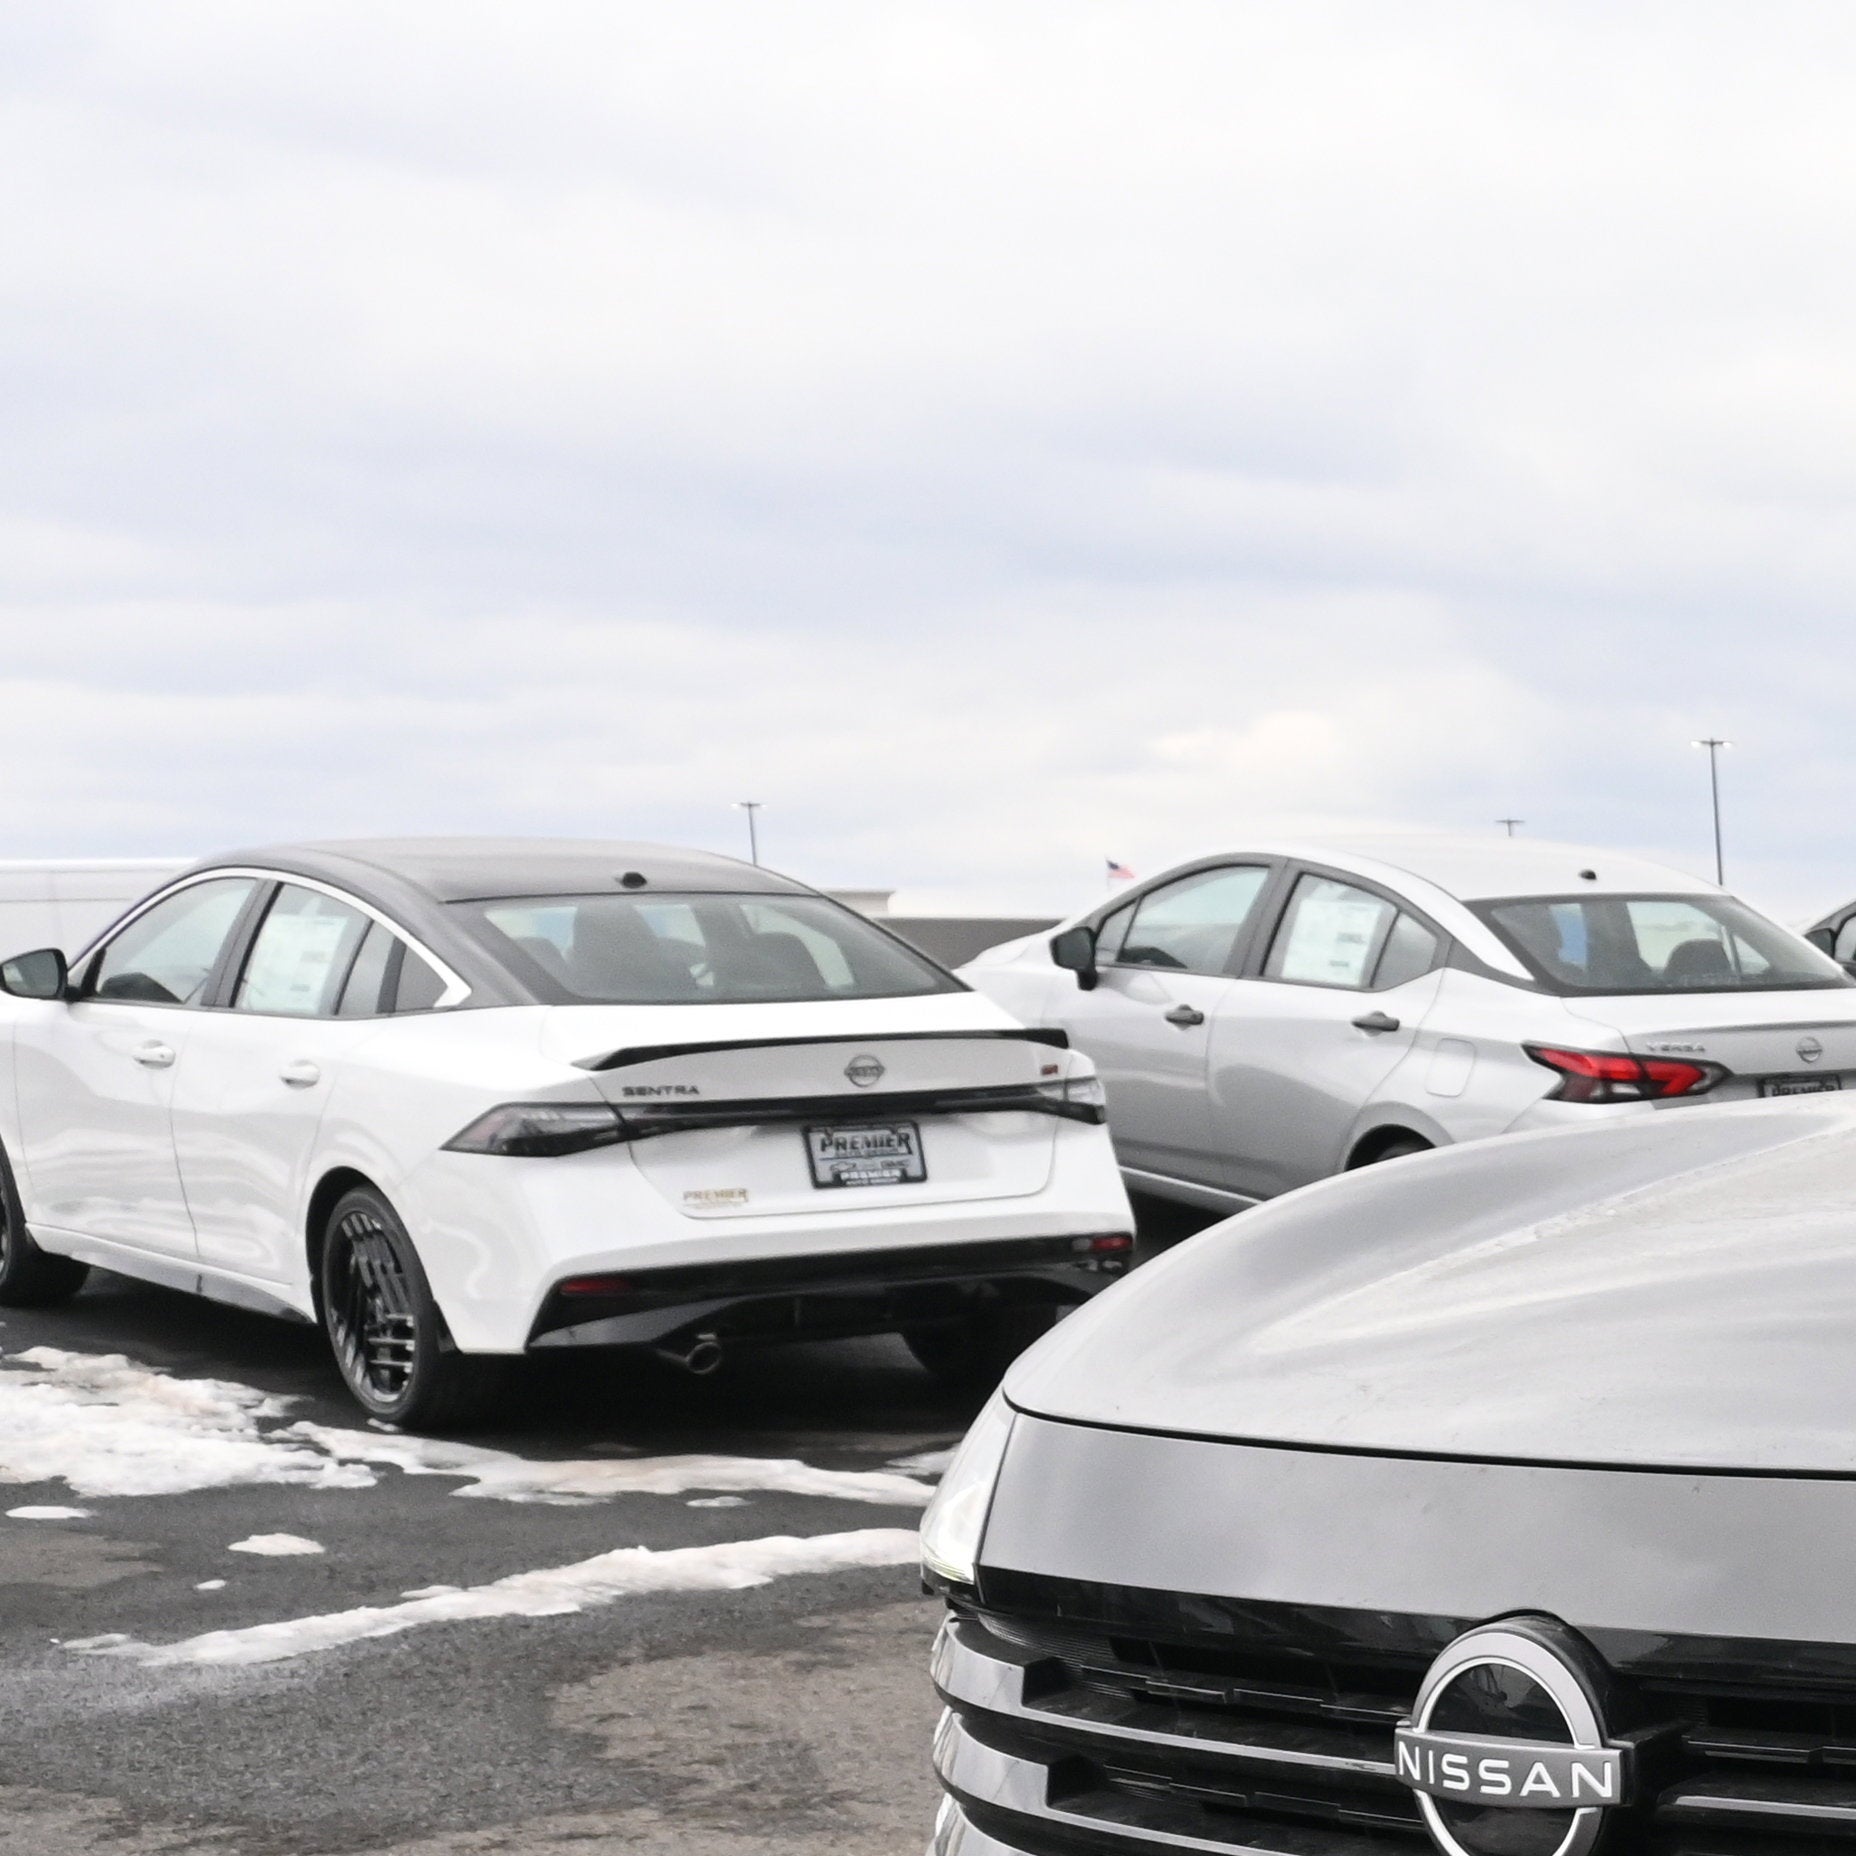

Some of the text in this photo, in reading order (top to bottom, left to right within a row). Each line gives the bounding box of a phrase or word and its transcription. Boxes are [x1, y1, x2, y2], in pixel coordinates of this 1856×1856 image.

[622, 1085, 700, 1097] SENTRA
[820, 1132, 913, 1154] PREMIER
[683, 1187, 749, 1203] PREMIER
[1397, 1739, 1613, 1799] NISSAN
